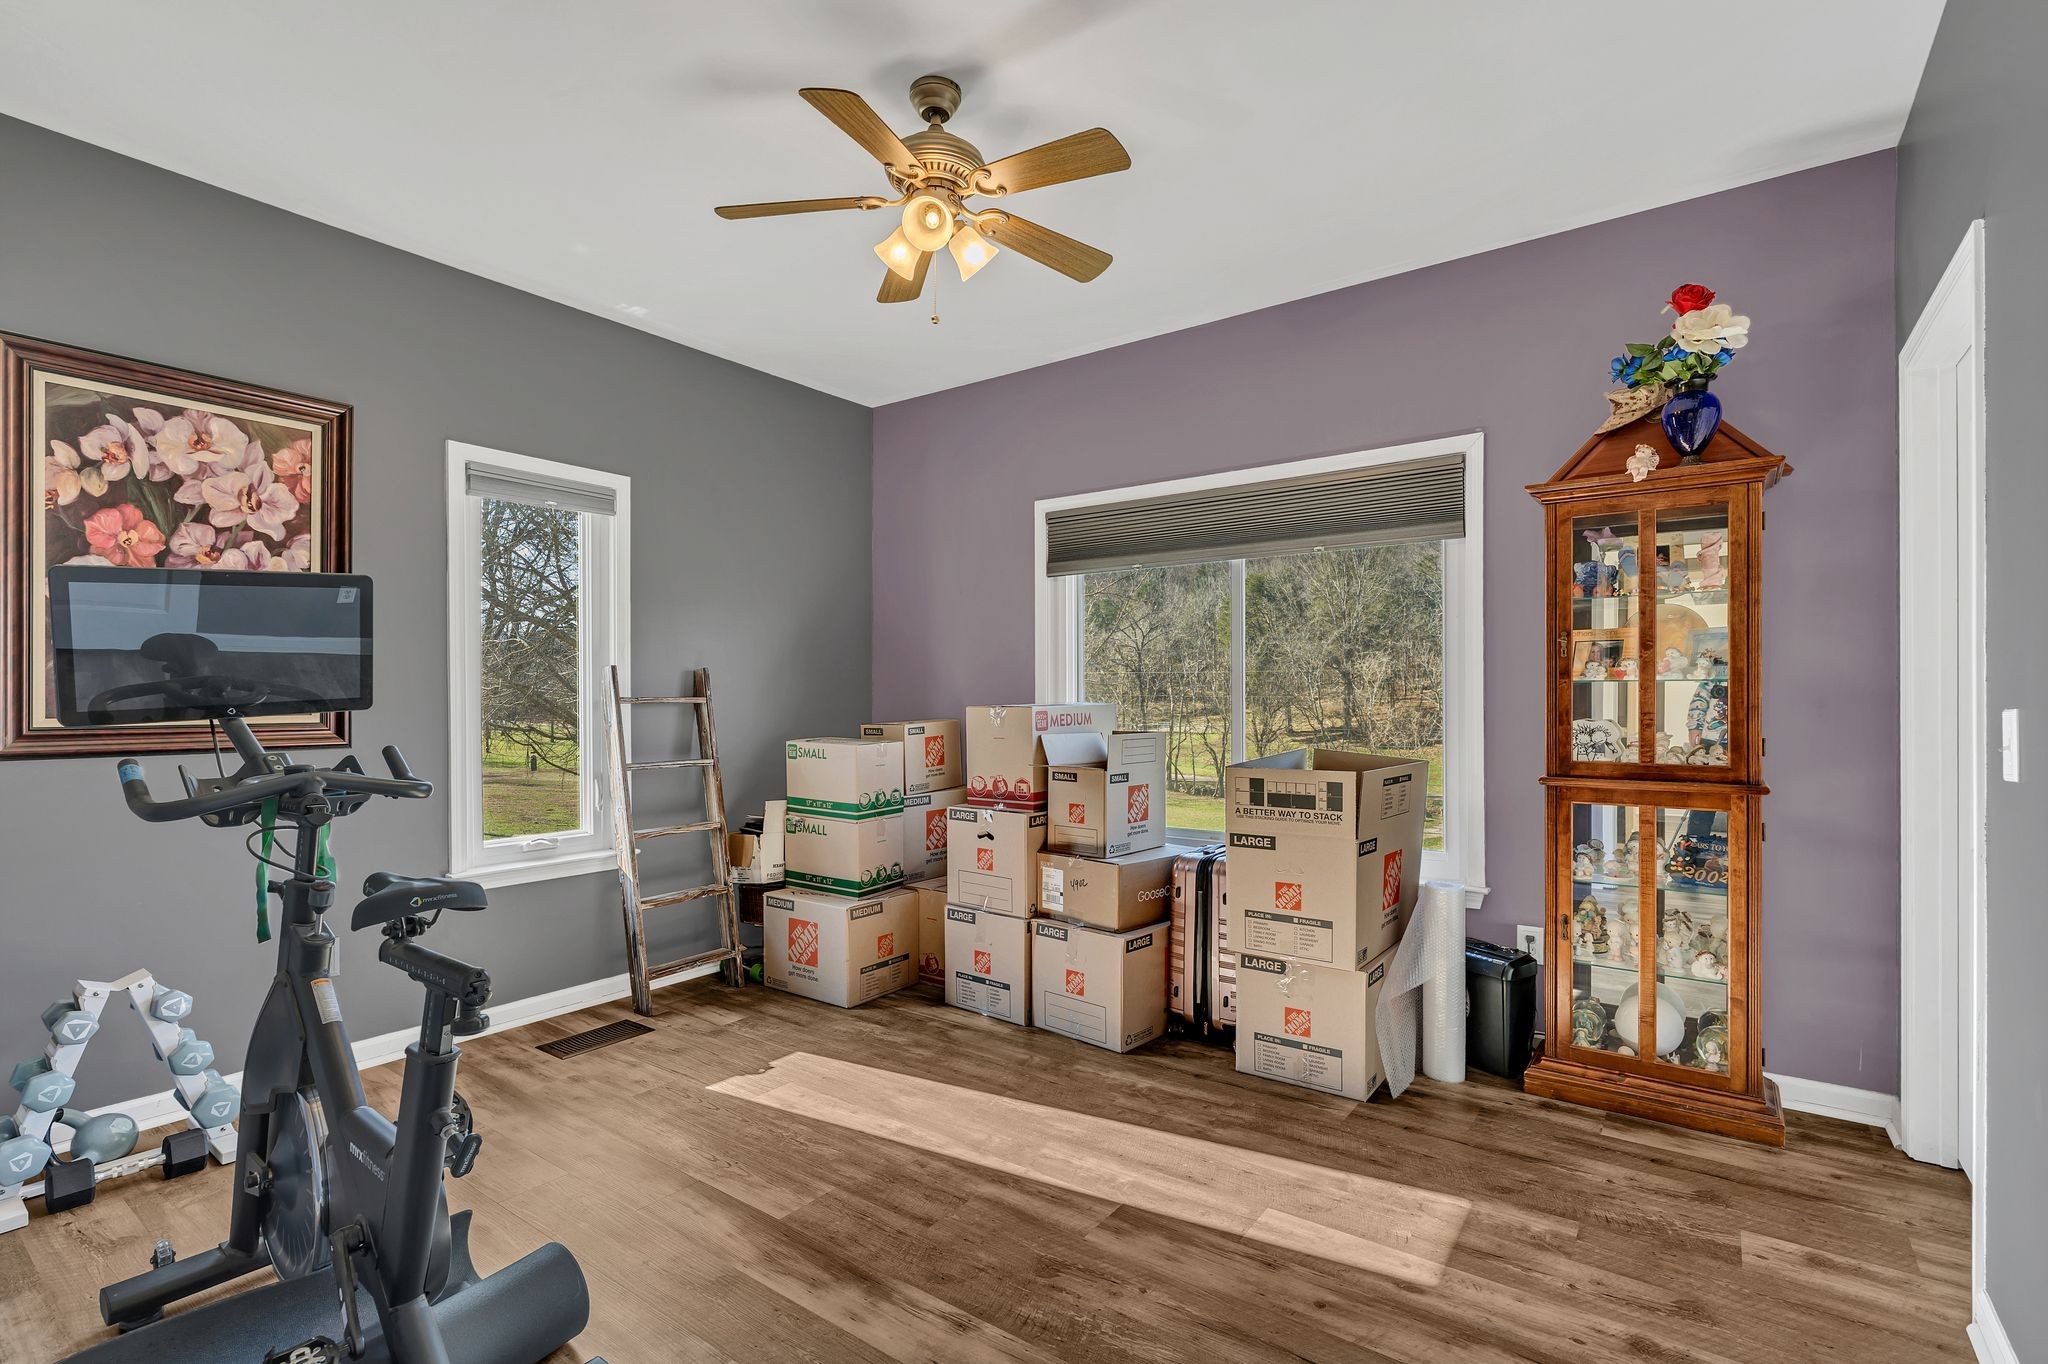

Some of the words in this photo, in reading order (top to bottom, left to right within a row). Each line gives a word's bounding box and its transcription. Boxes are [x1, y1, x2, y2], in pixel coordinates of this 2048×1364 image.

[1050, 713, 1092, 727] MEDIUM
[798, 747, 827, 760] SMALL
[904, 796, 930, 806] MEDIUM
[952, 811, 975, 820] LARGE
[1032, 816, 1047, 825] LAR
[1243, 808, 1276, 816] BETTER
[1278, 810, 1296, 818] WAY
[1314, 812, 1343, 821] STACK
[797, 820, 827, 836] SMALL
[1234, 836, 1271, 847] LARGE
[1360, 840, 1376, 854] LARGE
[1683, 866, 1728, 884] 2002
[768, 899, 793, 909] MEDIUM
[852, 905, 881, 918] MEDIUM
[950, 911, 973, 921] LARGE
[1299, 918, 1321, 926] FRAGILE
[1039, 925, 1064, 939] LARGE
[788, 922, 818, 962] HOME
[1128, 936, 1151, 950] LARGE
[1245, 957, 1282, 972] LARGE
[1370, 966, 1383, 983] LARGE
[1285, 1012, 1310, 1034] HOME
[1308, 1046, 1331, 1054] FRAGILE
